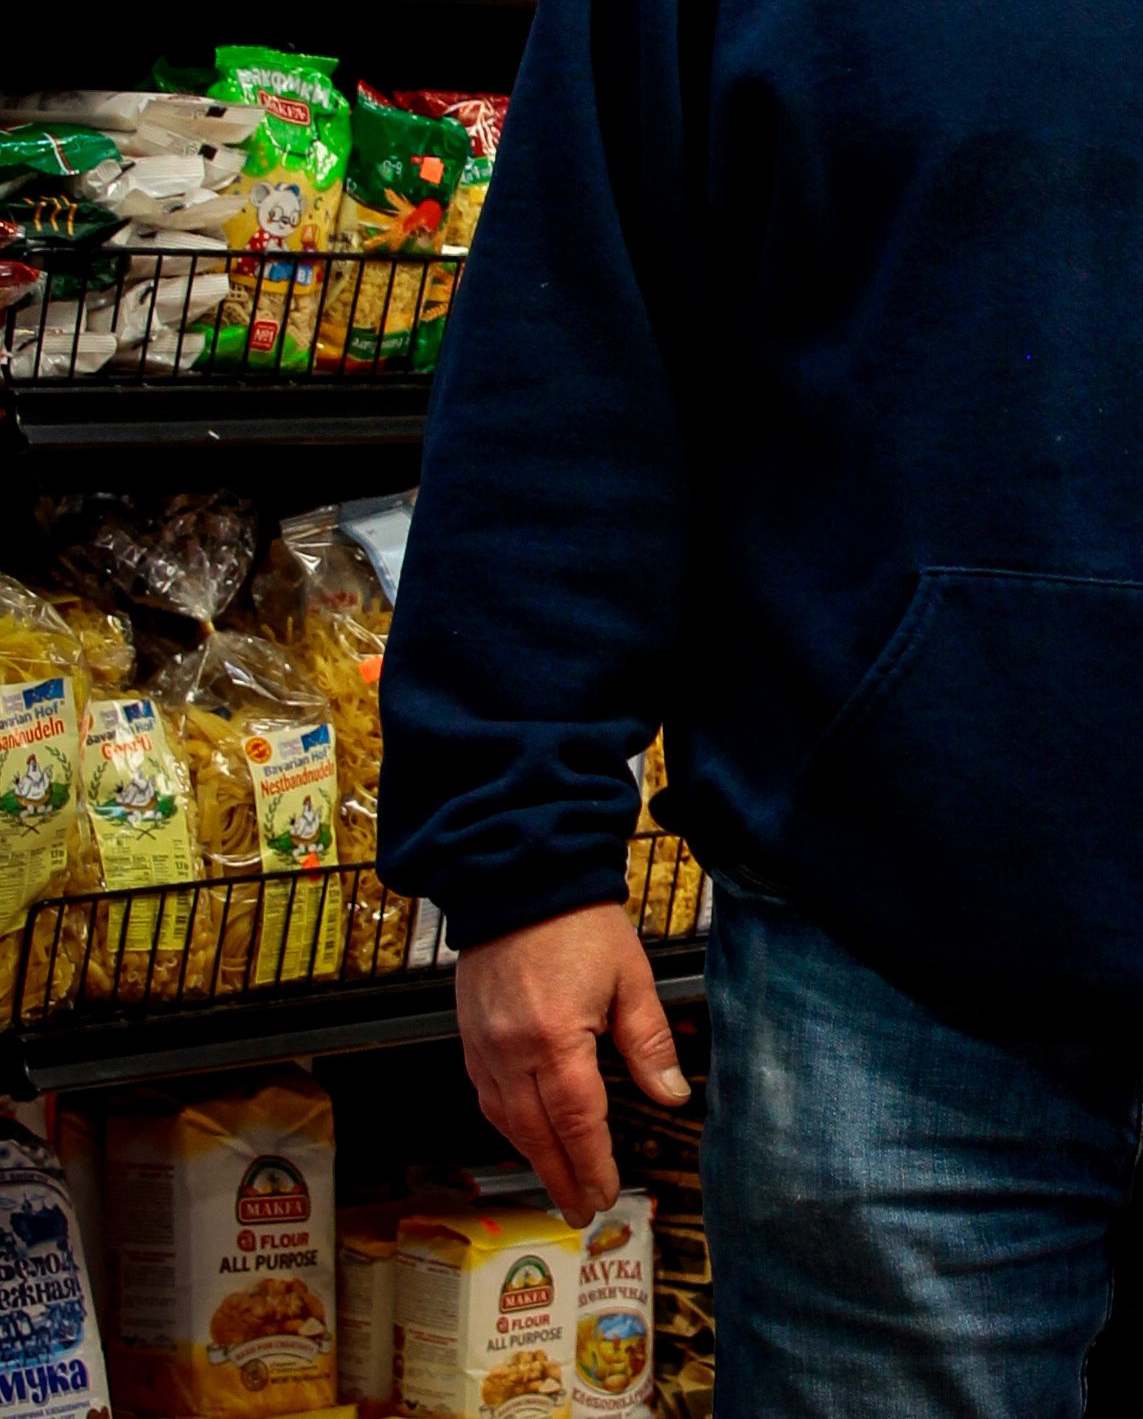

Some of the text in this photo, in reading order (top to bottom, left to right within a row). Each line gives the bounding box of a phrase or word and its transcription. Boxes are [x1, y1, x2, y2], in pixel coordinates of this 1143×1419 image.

[34, 703, 59, 720] Hof
[0, 717, 65, 752] andnudeln
[264, 747, 329, 778] Bavarian Hof
[261, 1231, 310, 1250] FLOUR
[219, 1250, 319, 1274] ALL PURPOSE
[579, 1259, 643, 1286] МУКА
[511, 1314, 551, 1331] FLOUR
[486, 1327, 563, 1352] ALL PURPOSE
